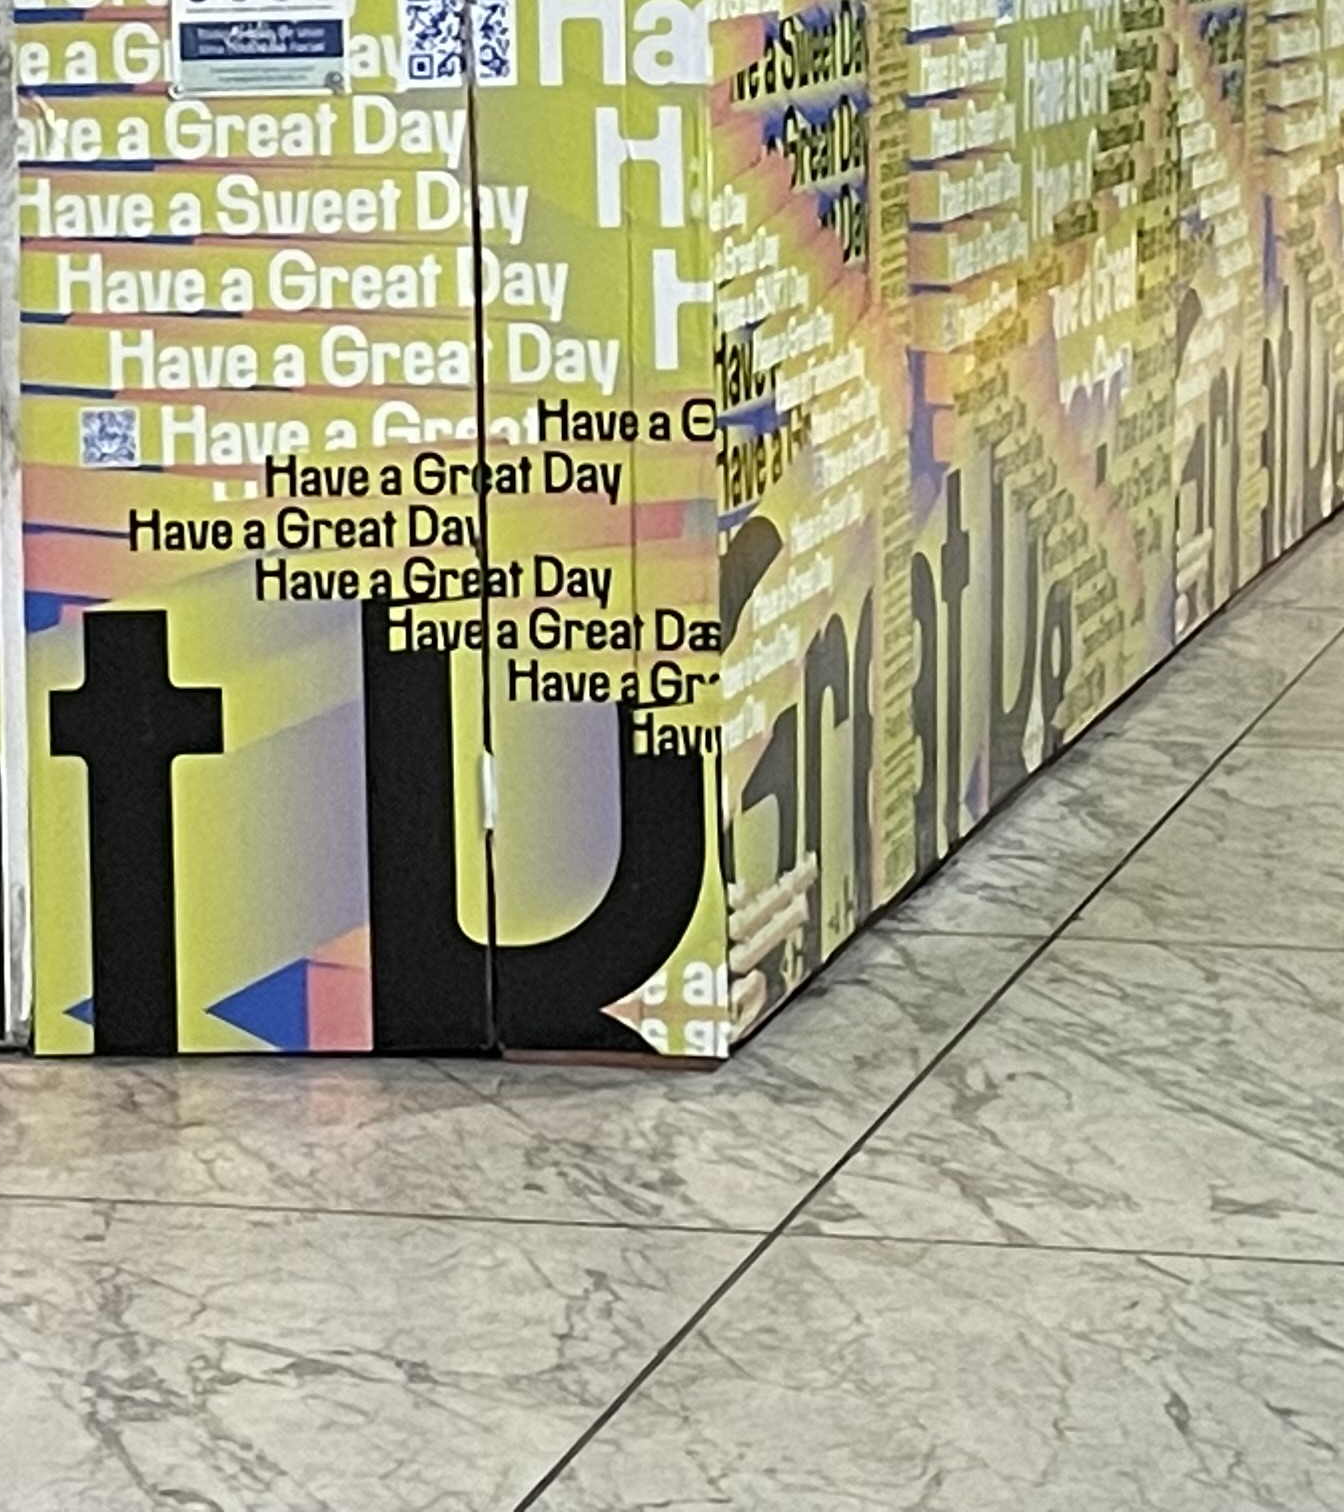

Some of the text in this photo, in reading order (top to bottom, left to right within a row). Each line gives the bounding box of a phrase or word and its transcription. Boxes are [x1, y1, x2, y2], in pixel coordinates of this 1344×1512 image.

[17, 170, 530, 245] Have a Sweet Day
[58, 246, 569, 322] Have a Great Day
[265, 451, 623, 503] Have a Great Day
[129, 508, 233, 552] Have
[243, 517, 266, 549] a
[277, 506, 397, 548] Great
[255, 555, 613, 608] Have a Great Day
